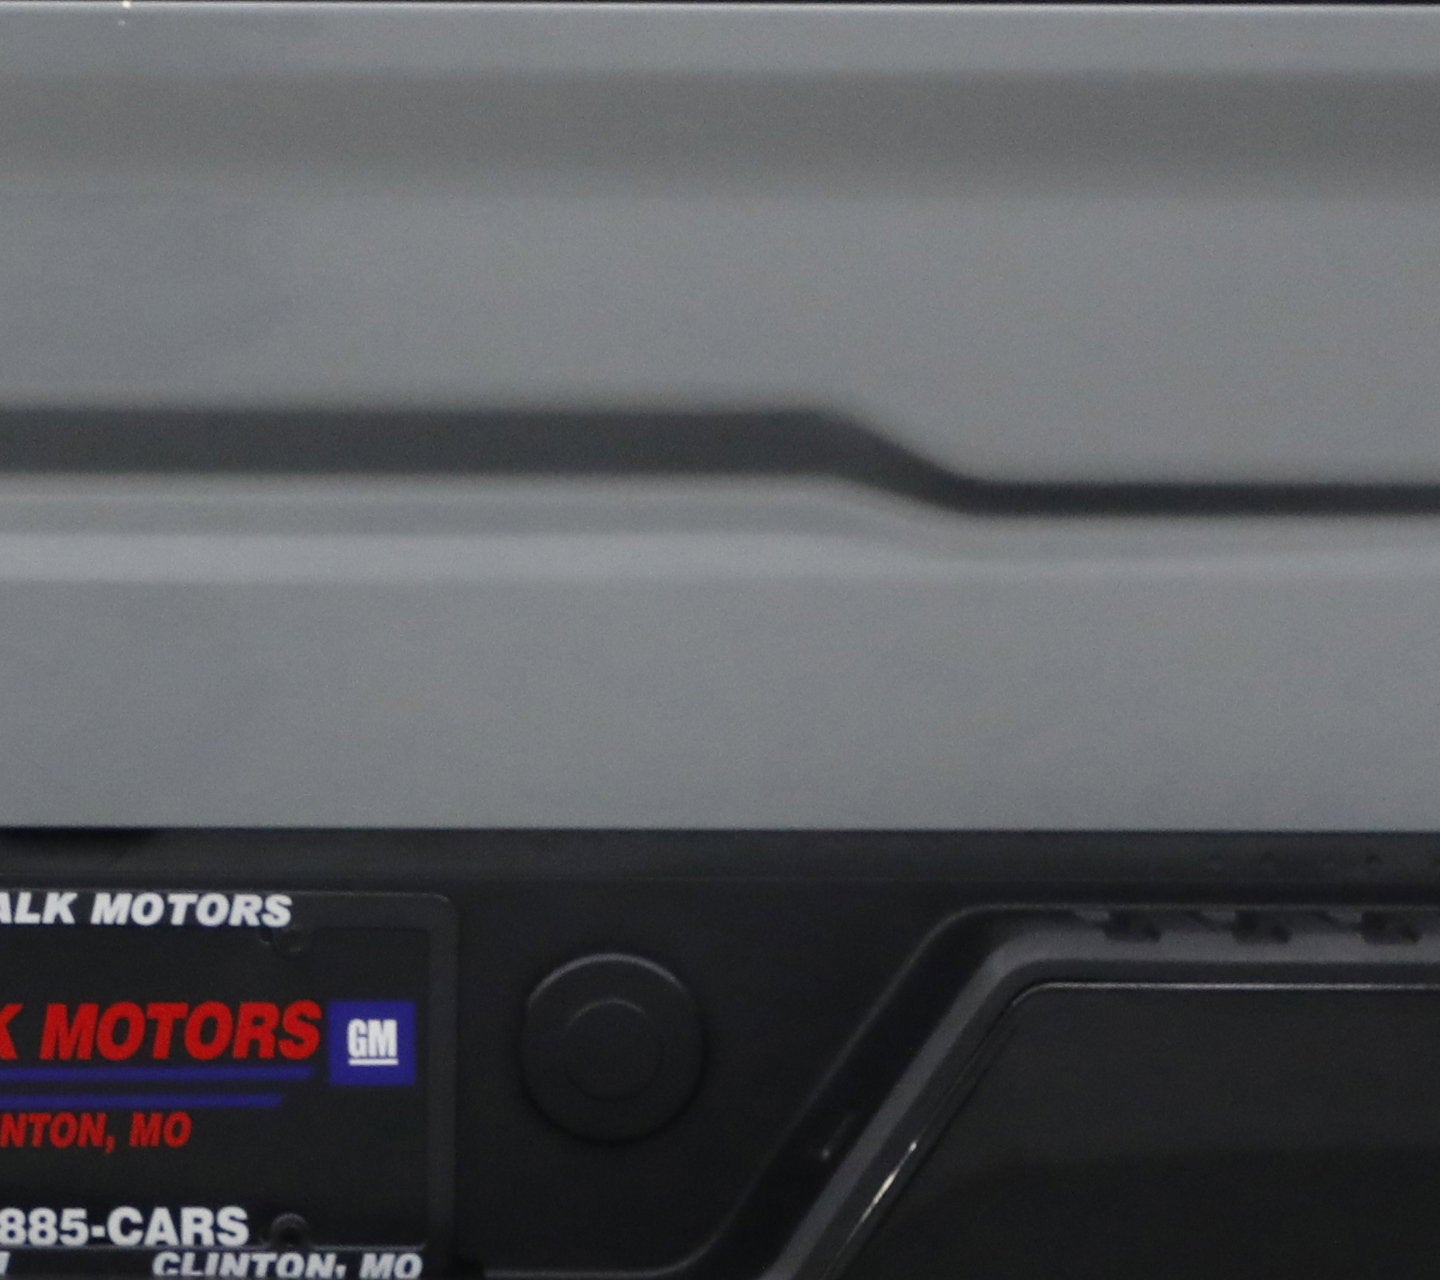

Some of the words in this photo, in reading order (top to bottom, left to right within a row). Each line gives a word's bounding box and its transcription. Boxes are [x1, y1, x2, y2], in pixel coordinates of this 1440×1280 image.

[90, 891, 294, 929] MOTORS
[39, 999, 324, 1063] MOTORS
[346, 1017, 400, 1067] GM
[129, 1111, 195, 1150] MO
